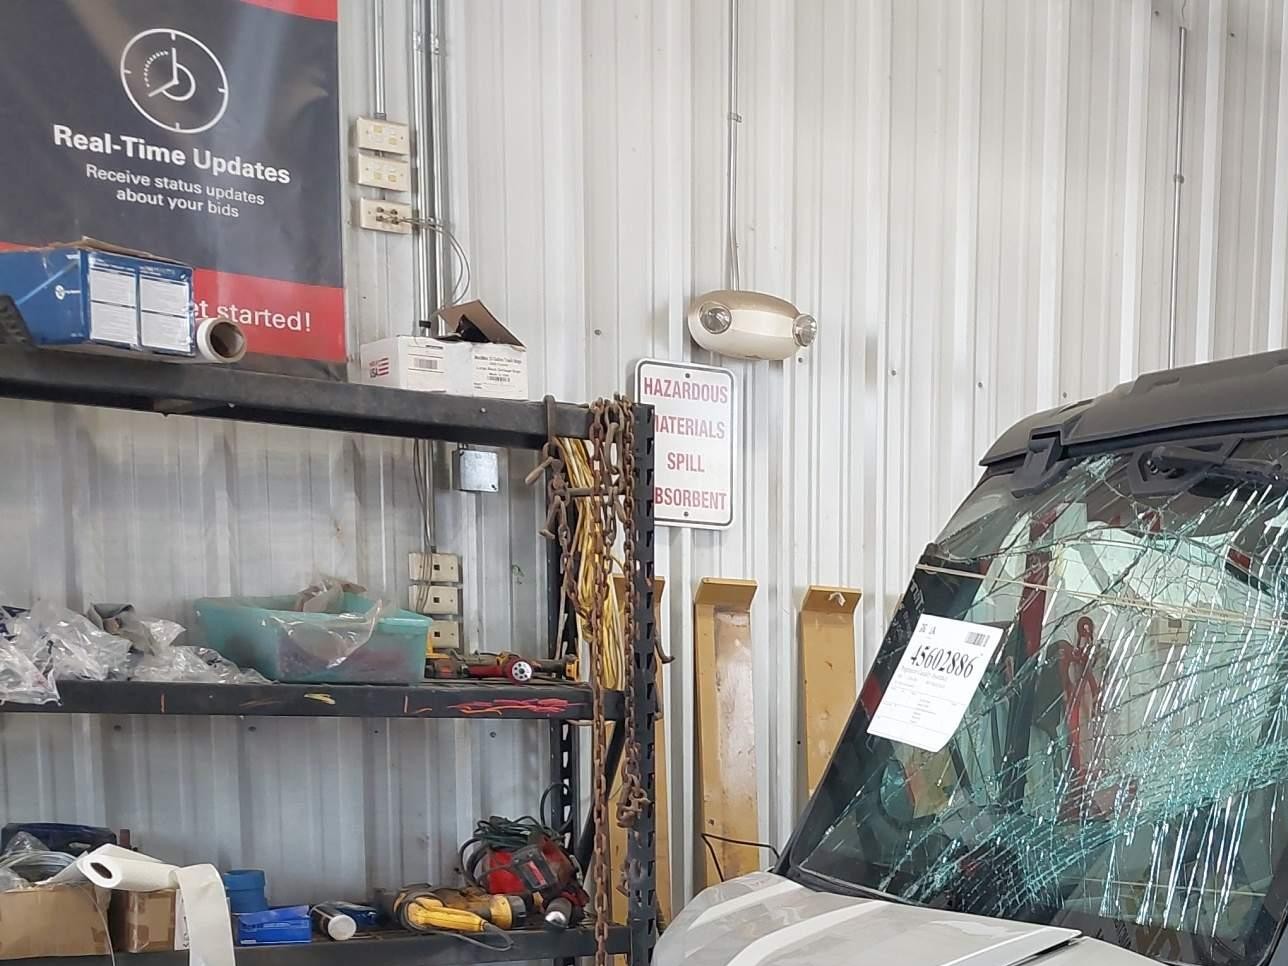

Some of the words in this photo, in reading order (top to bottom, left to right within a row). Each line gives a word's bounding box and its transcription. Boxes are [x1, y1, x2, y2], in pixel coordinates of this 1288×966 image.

[53, 124, 186, 165] Real-Time
[193, 148, 291, 184] Updates
[86, 164, 150, 187] Receive
[154, 176, 202, 194] status
[206, 185, 265, 206] updates
[116, 188, 164, 206] about
[167, 196, 203, 211] your
[207, 200, 239, 217] bids
[193, 300, 208, 318] et
[217, 303, 311, 332] started!
[644, 377, 728, 403] HAZARDOUS
[667, 452, 705, 472] SPILL
[655, 487, 727, 510] BSORBENT
[910, 644, 980, 678] 45602886
